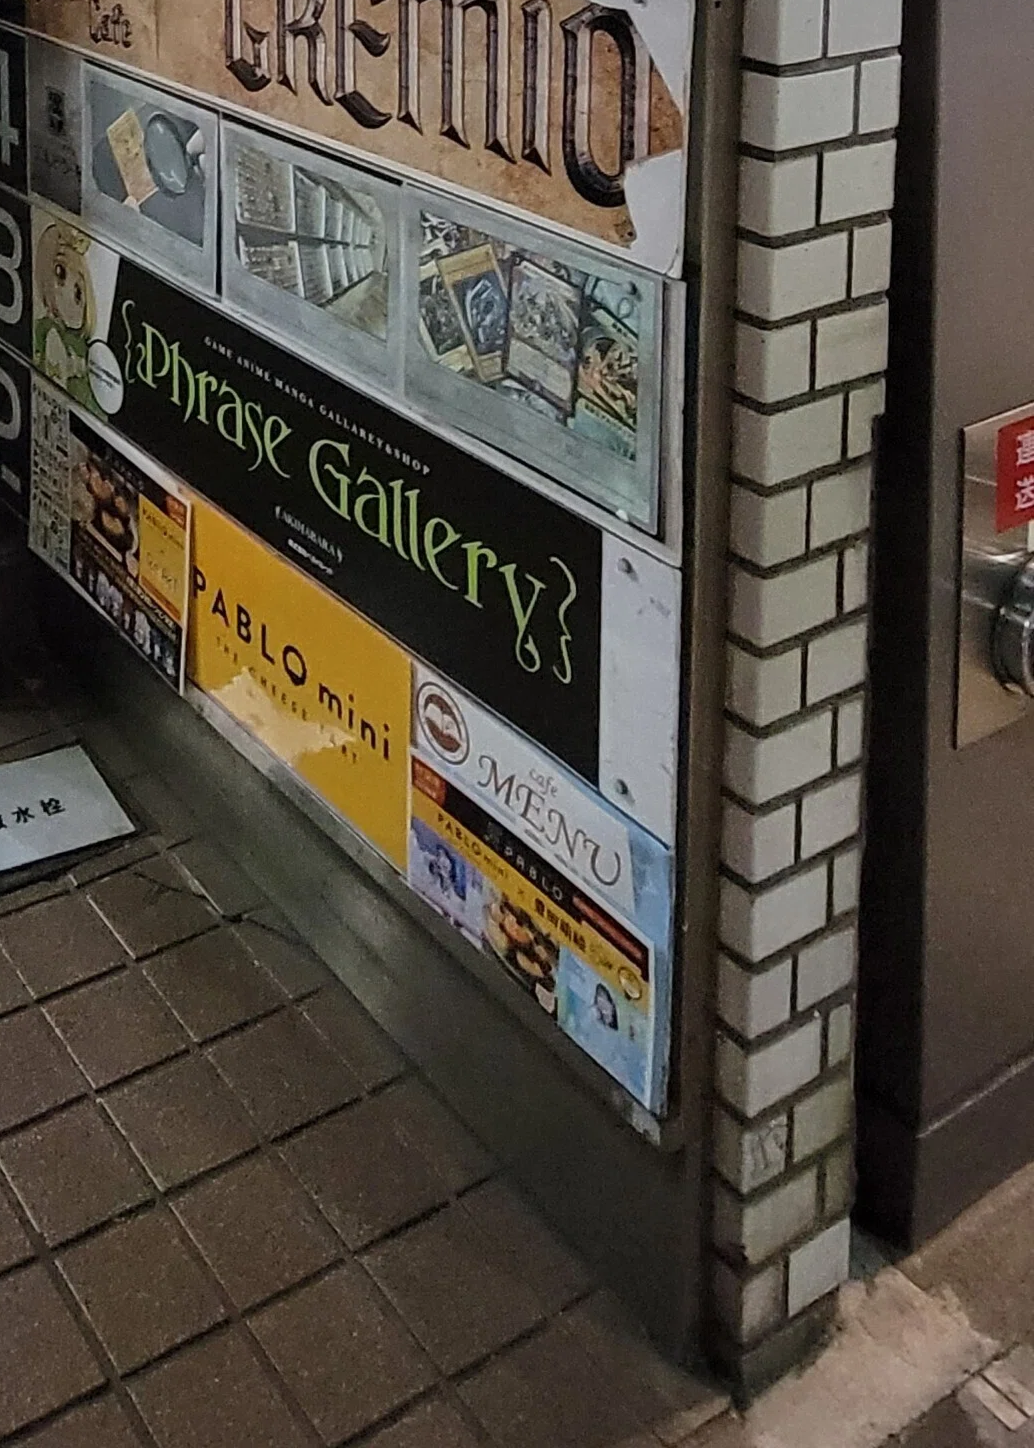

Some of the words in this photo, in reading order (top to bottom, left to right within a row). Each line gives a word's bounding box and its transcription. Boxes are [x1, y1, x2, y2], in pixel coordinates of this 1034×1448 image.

[192, 564, 307, 686] PABLO
[318, 682, 391, 761] mini
[476, 754, 622, 887] MENU
[529, 767, 559, 798] cafe
